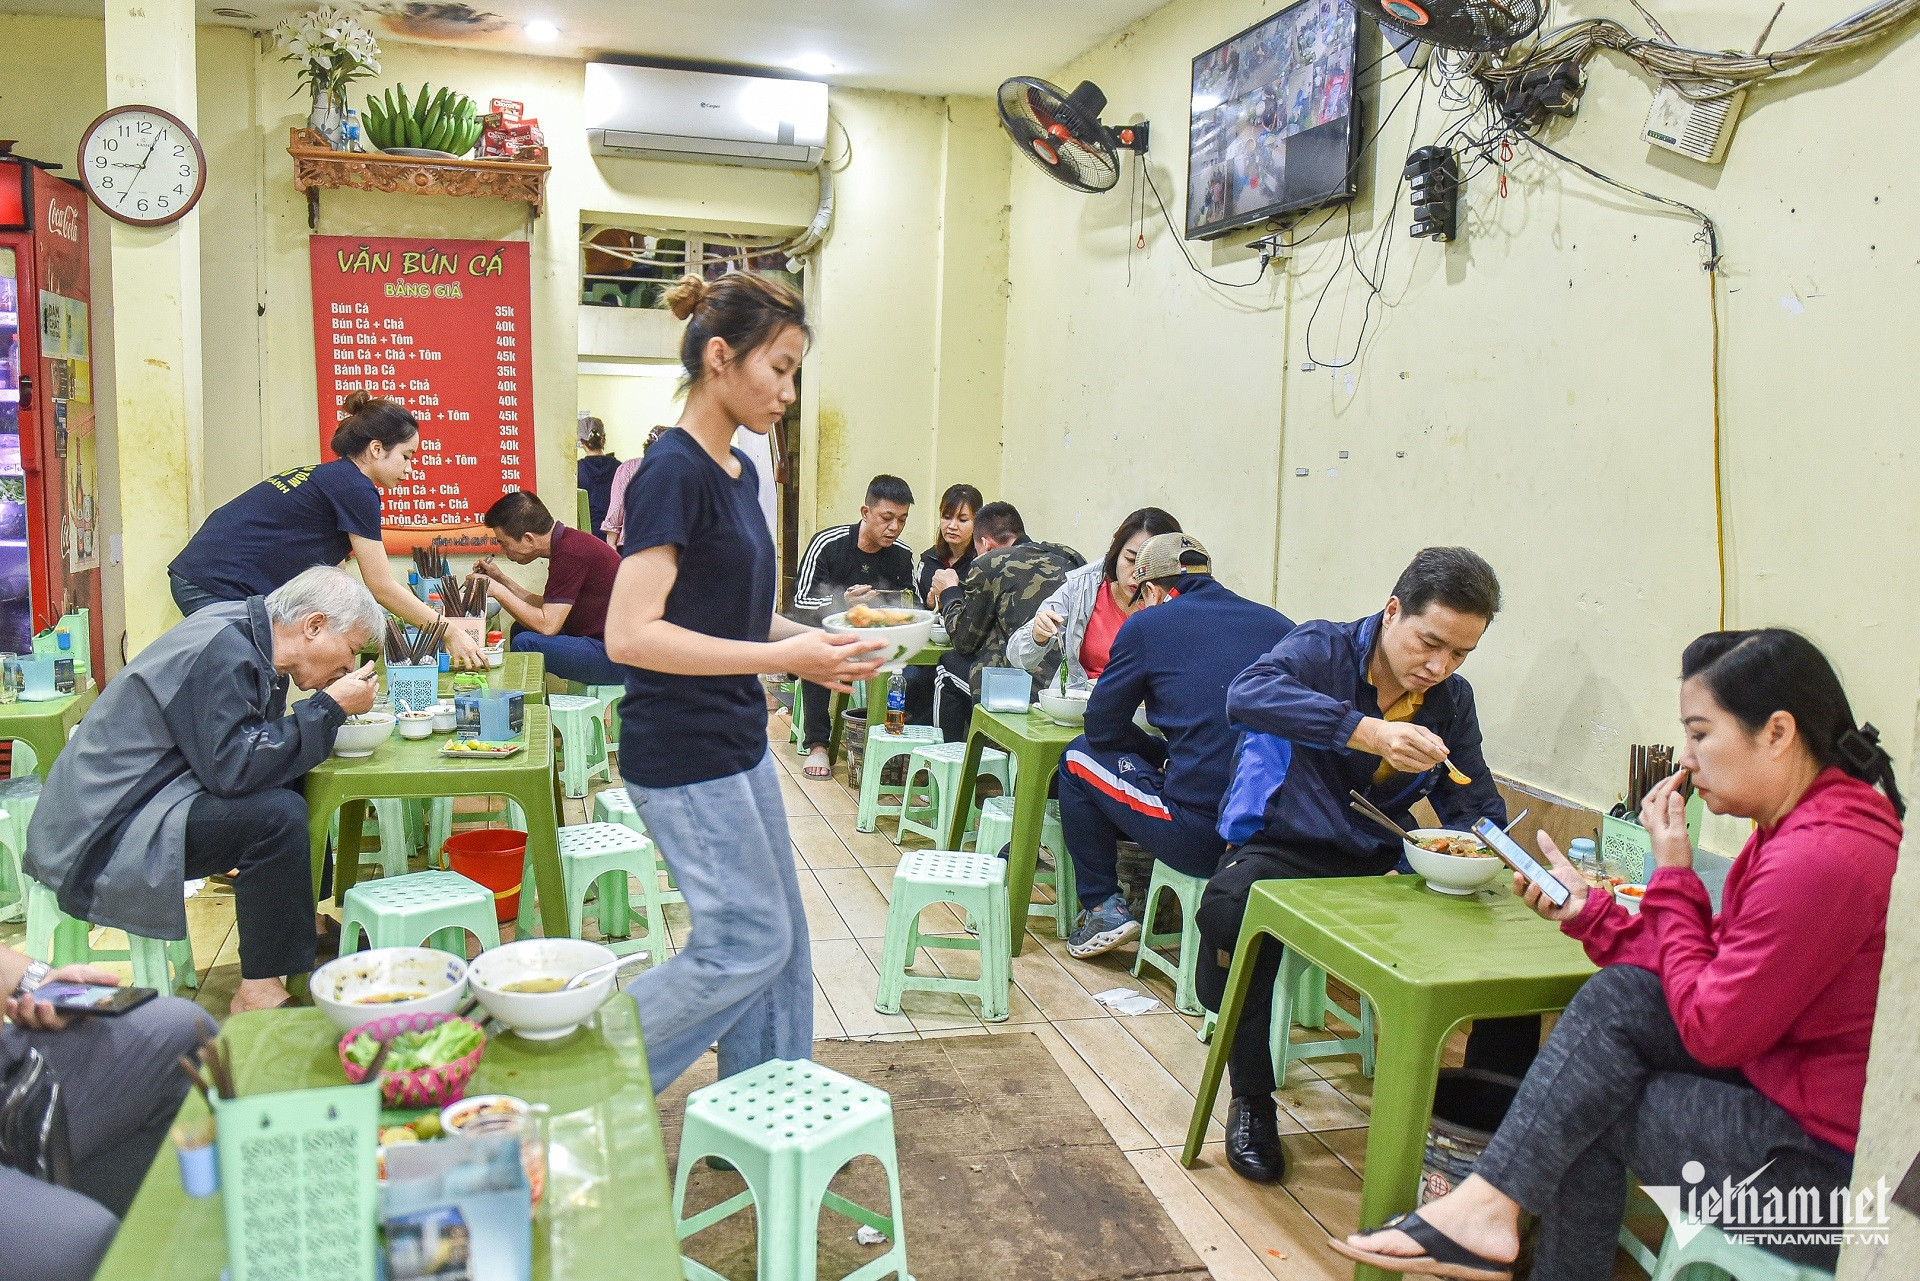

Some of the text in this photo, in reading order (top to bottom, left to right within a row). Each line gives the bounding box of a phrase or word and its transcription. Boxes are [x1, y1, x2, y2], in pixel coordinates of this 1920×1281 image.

[118, 125, 130, 137] 11
[136, 121, 152, 134] 12
[102, 139, 118, 151] 10
[173, 145, 184, 157] 2
[96, 156, 107, 168] 9
[179, 164, 190, 177] 3
[102, 176, 113, 188] 8
[172, 184, 184, 195] 4
[117, 191, 128, 203] 7
[158, 195, 169, 208] 5
[137, 199, 148, 211] 6
[337, 246, 504, 276] VĂN BÚN CÁ
[384, 278, 462, 298] BẢNG GIÁ
[331, 302, 369, 314] Bún Cá
[495, 306, 514, 317] 35k
[332, 318, 353, 329] Bún
[356, 318, 370, 329] Cá
[384, 317, 404, 330] Chả
[496, 321, 515, 332] 40k
[333, 332, 414, 345] Bún Chả + Tôm
[496, 336, 515, 346] 40k
[334, 349, 354, 360] Bún
[357, 349, 371, 360] Cá
[385, 348, 406, 360] Chả
[419, 350, 442, 360] Tôm
[496, 351, 516, 361] 45k
[334, 364, 362, 375] Bánh
[382, 364, 396, 375] Cá
[497, 366, 516, 376] 35k
[335, 380, 362, 390] Bánh
[382, 379, 396, 390] Cá
[399, 382, 406, 390] +
[409, 378, 430, 390] Chả
[497, 381, 516, 391] 40k
[419, 394, 439, 406] Chả
[498, 396, 517, 406] 40k
[411, 408, 470, 420] Chả + Tôm
[498, 411, 518, 421] 45k
[499, 425, 518, 436] 35k
[421, 438, 441, 450] Chả
[500, 440, 519, 450] 40k
[421, 453, 442, 466] Chả
[455, 454, 477, 465] Tôm
[500, 455, 520, 465] 45k
[411, 469, 426, 480] Cá
[501, 469, 520, 479] 35k
[412, 484, 426, 495] Cá
[440, 483, 460, 494] Chả
[502, 484, 520, 494] 40k
[388, 499, 410, 512] Trộn
[413, 500, 435, 509] Tôm
[449, 498, 469, 509] Chả
[413, 514, 428, 525] Cá
[431, 516, 438, 524] +
[441, 512, 460, 524] Chả
[474, 513, 485, 523] Tô
